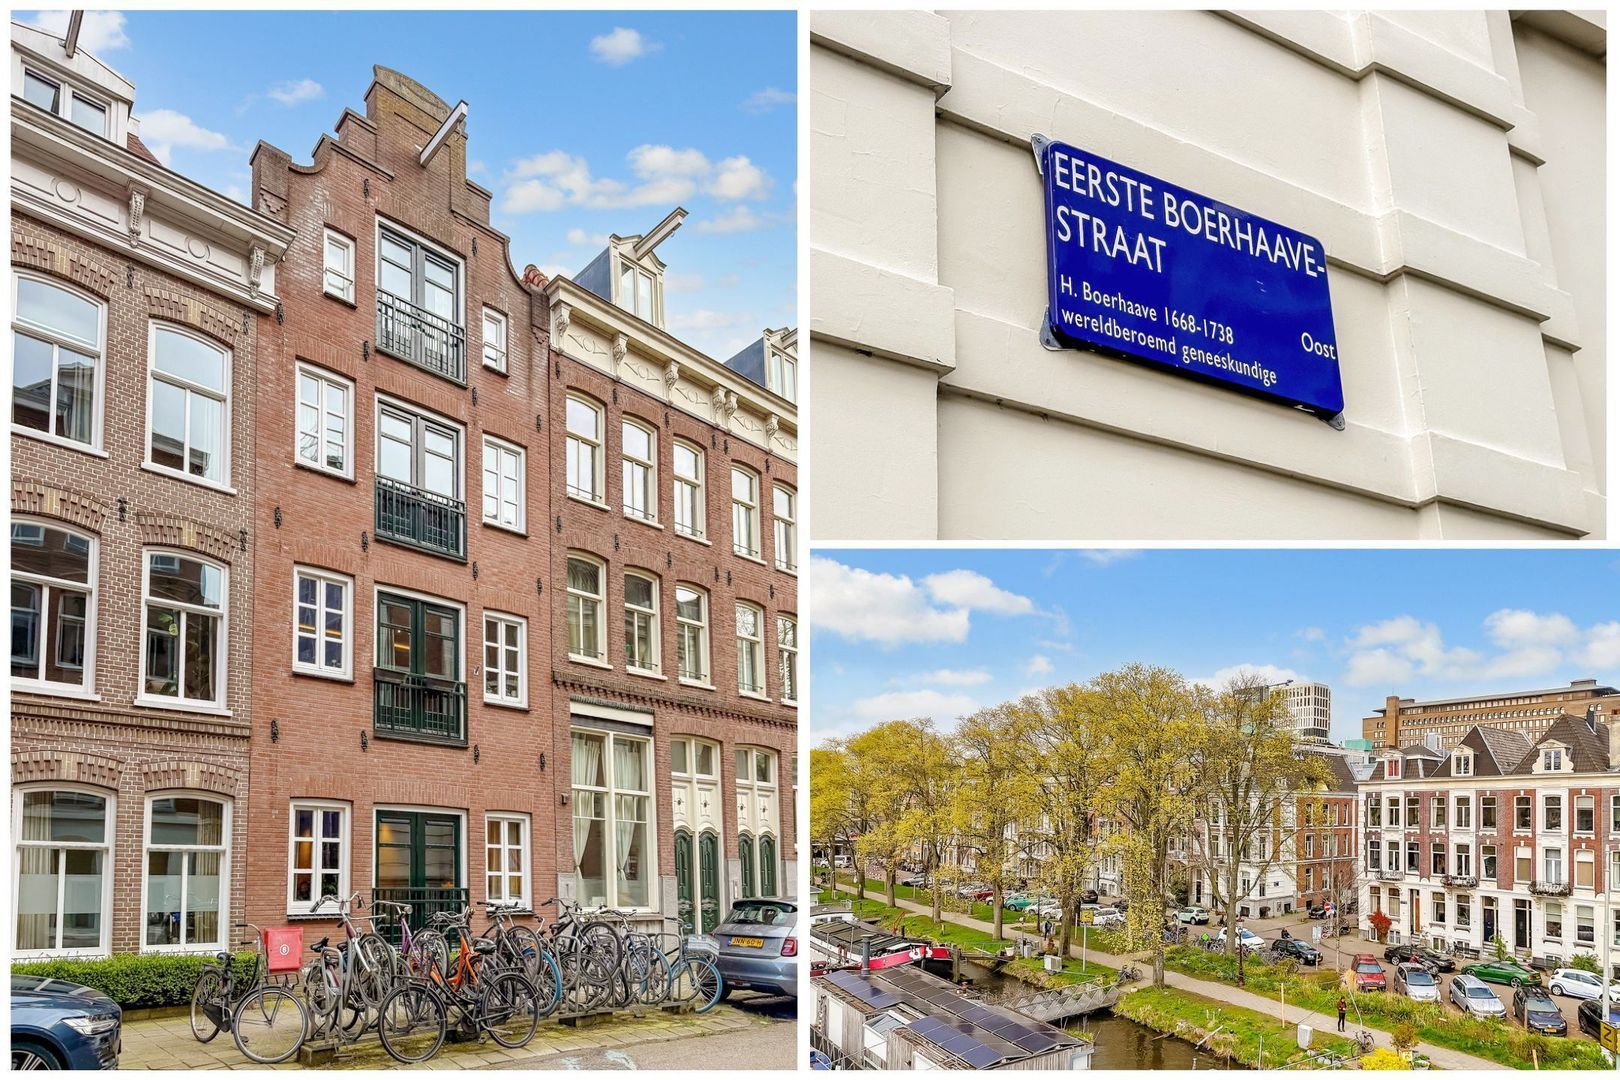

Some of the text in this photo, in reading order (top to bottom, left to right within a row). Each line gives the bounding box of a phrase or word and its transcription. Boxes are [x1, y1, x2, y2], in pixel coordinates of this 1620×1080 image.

[1055, 152, 1325, 277] EERSTE BOERHAAVE-
[1057, 206, 1166, 273] STRAAT
[1061, 274, 1233, 344] H. Boerhaave 1668-1738
[1062, 309, 1277, 386] wereldberoemd geneeskundige
[1302, 333, 1335, 359] Oost
